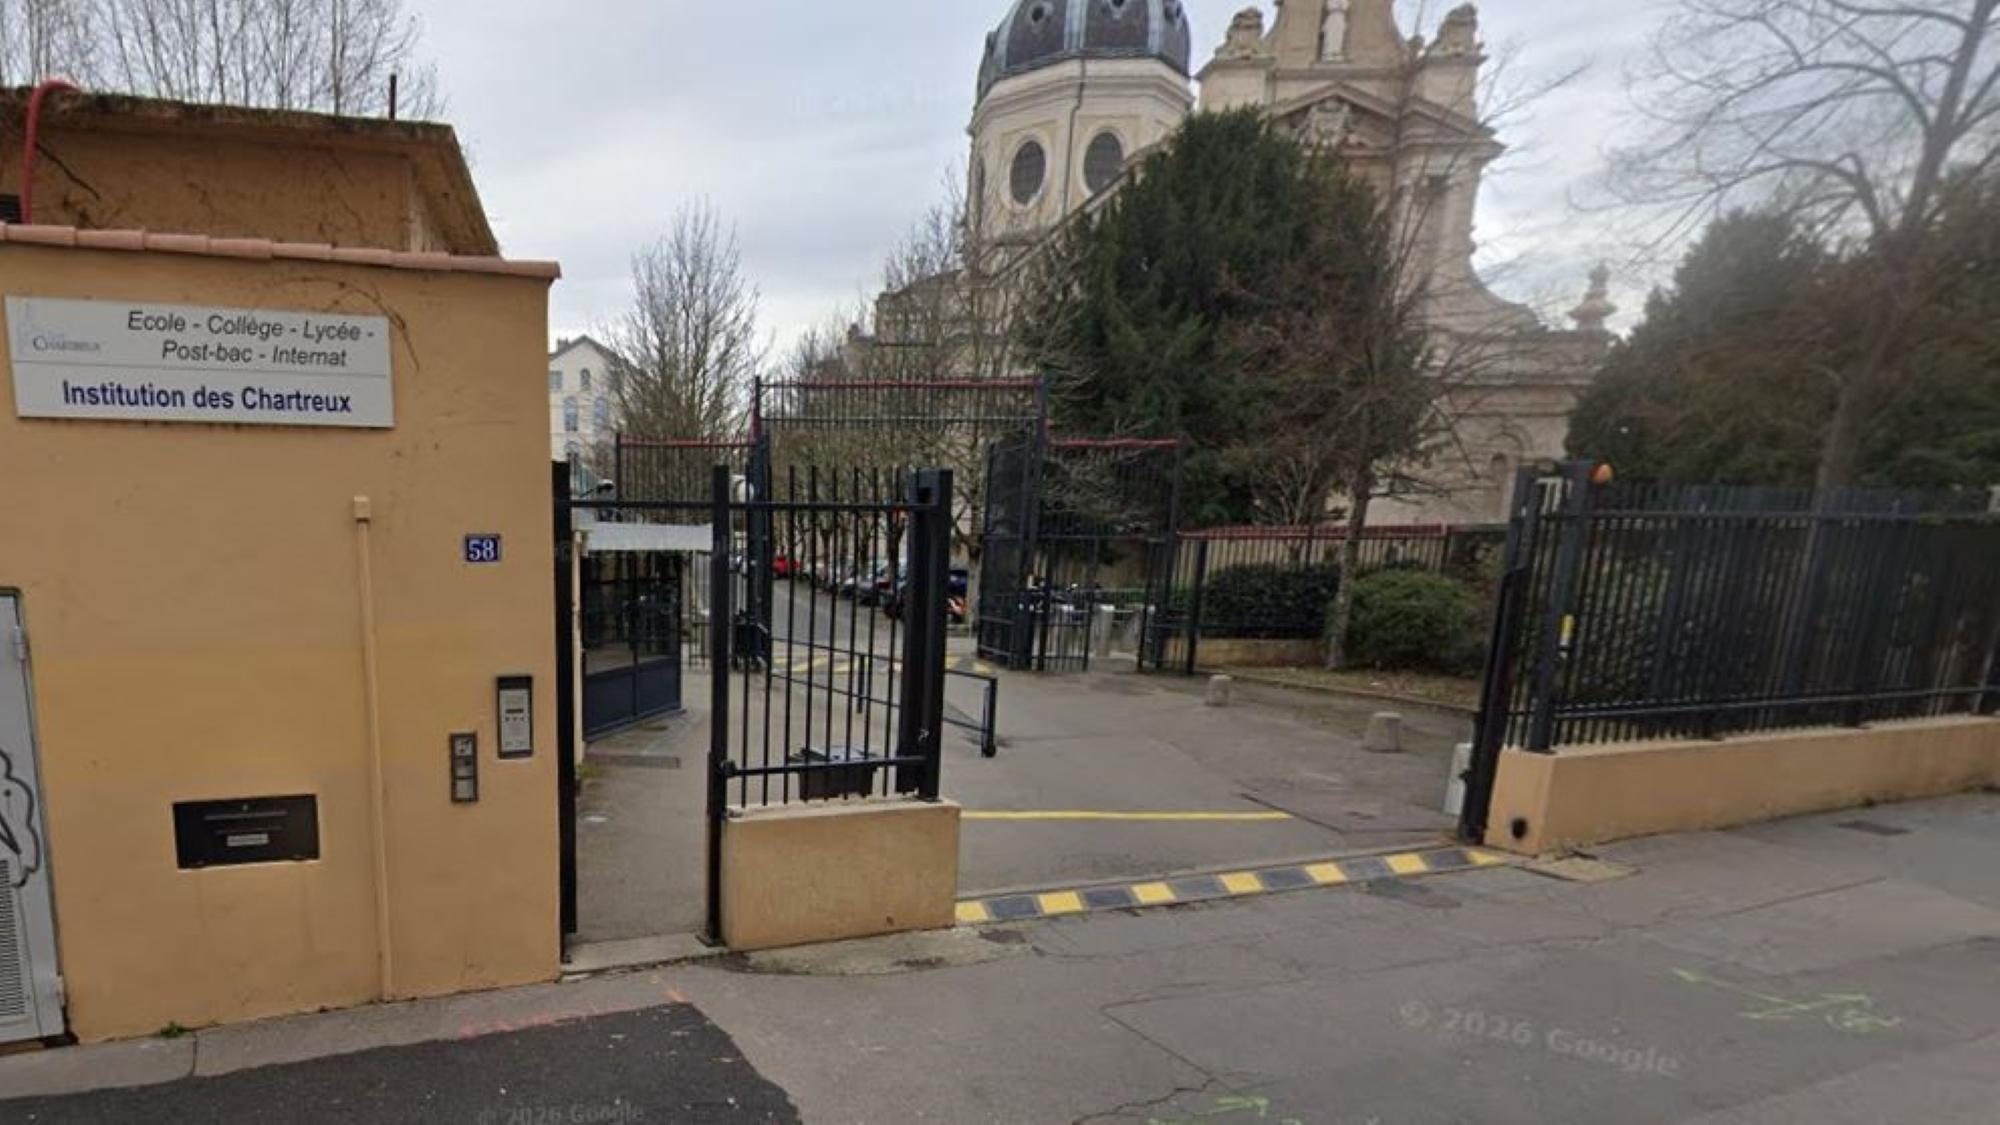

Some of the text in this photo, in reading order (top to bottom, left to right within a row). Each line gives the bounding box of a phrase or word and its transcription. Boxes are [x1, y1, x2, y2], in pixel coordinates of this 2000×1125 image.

[127, 310, 186, 333] Ecole
[303, 319, 361, 343] Lycée
[162, 339, 253, 364] Post-bac
[272, 342, 347, 367] Internat
[62, 380, 352, 413] Institution des Chartreux
[469, 539, 494, 560] 58
